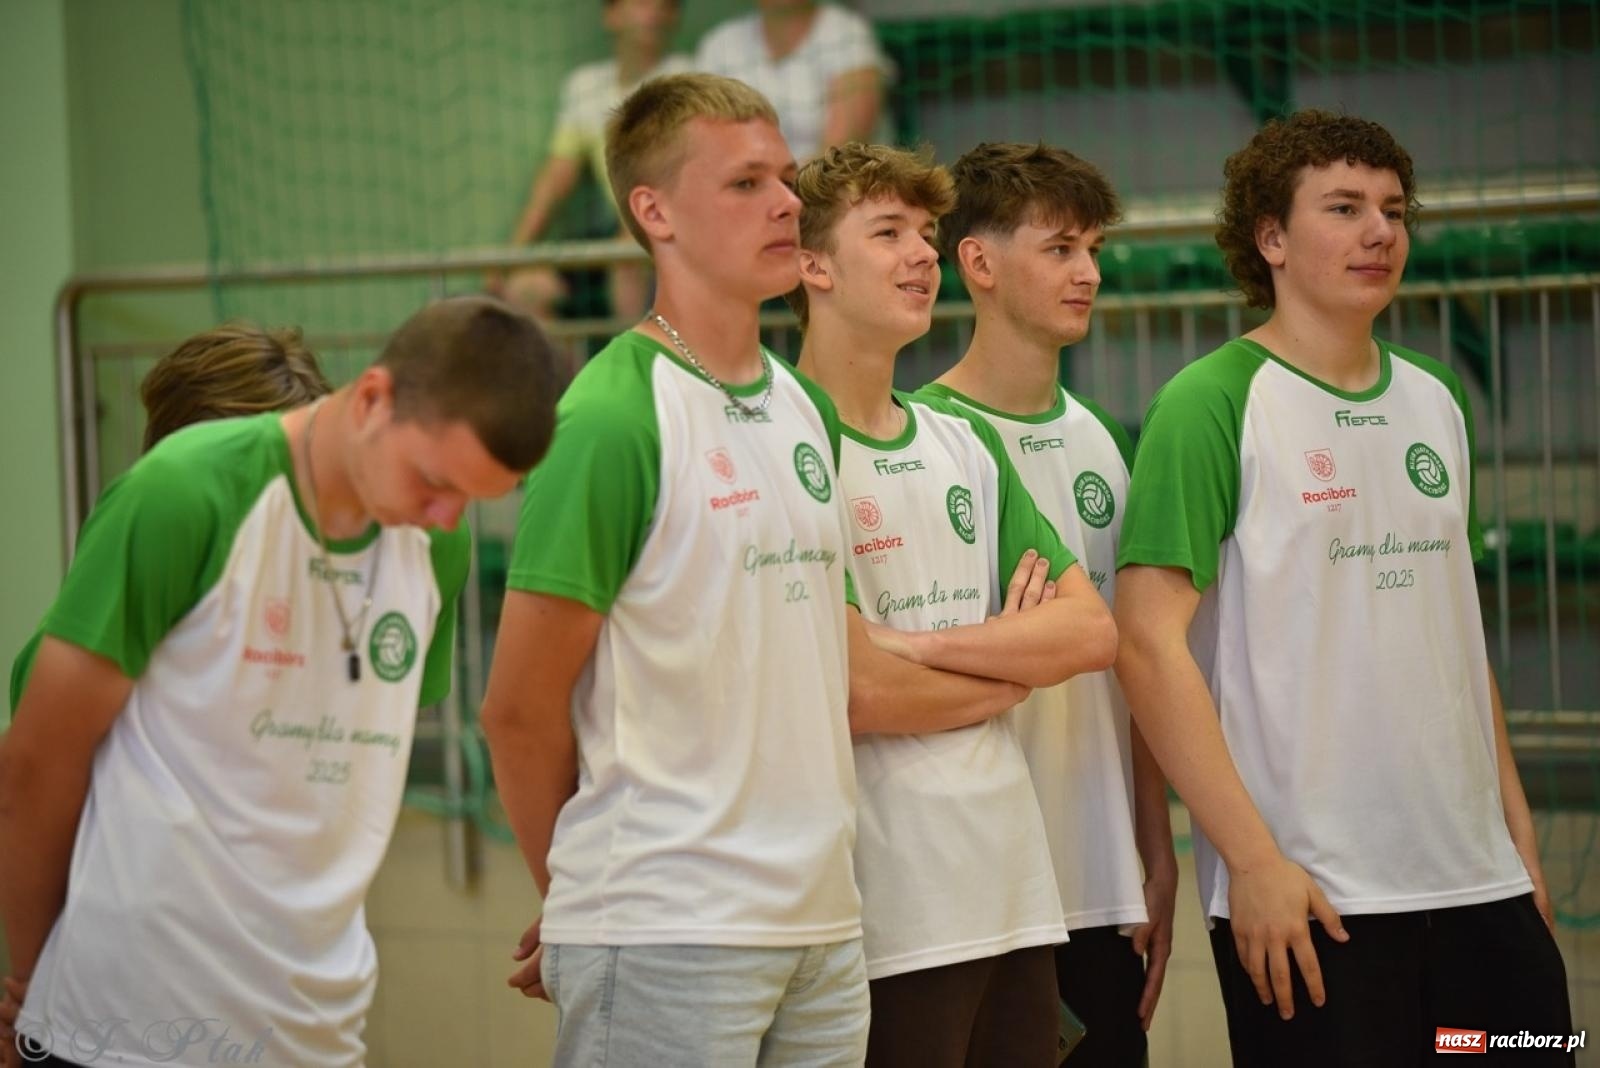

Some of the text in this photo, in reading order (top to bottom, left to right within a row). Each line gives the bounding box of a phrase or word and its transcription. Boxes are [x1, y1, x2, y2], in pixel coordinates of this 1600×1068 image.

[1301, 486, 1357, 504] Racibórz
[852, 535, 904, 557] acibórz
[1328, 531, 1452, 565] Gramy dla mamy
[1375, 568, 1415, 590] 2025
